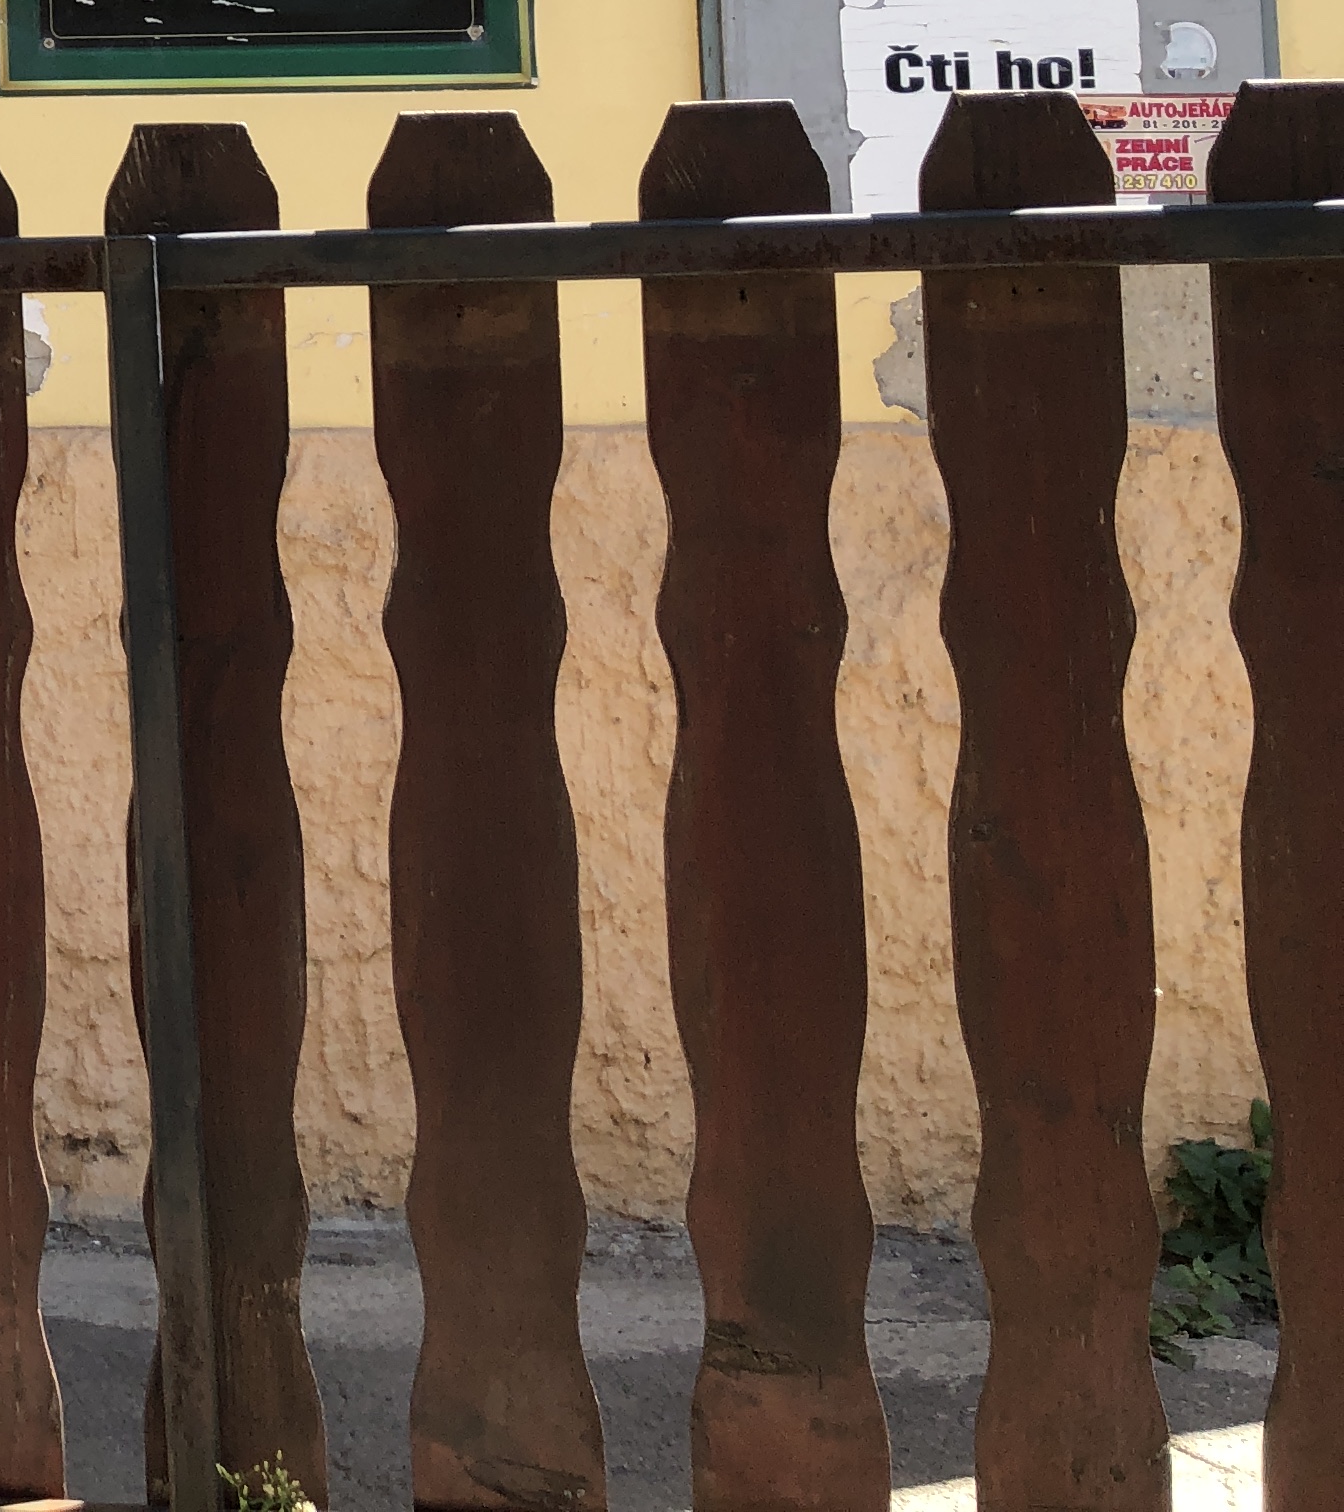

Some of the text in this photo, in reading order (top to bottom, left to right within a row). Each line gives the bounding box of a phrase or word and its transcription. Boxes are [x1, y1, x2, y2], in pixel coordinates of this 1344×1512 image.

[883, 44, 1097, 94] Čti ho!
[1171, 119, 1198, 129] 20t
[1115, 134, 1191, 154] ZEMNÍ
[1115, 153, 1194, 172] PRÁCE
